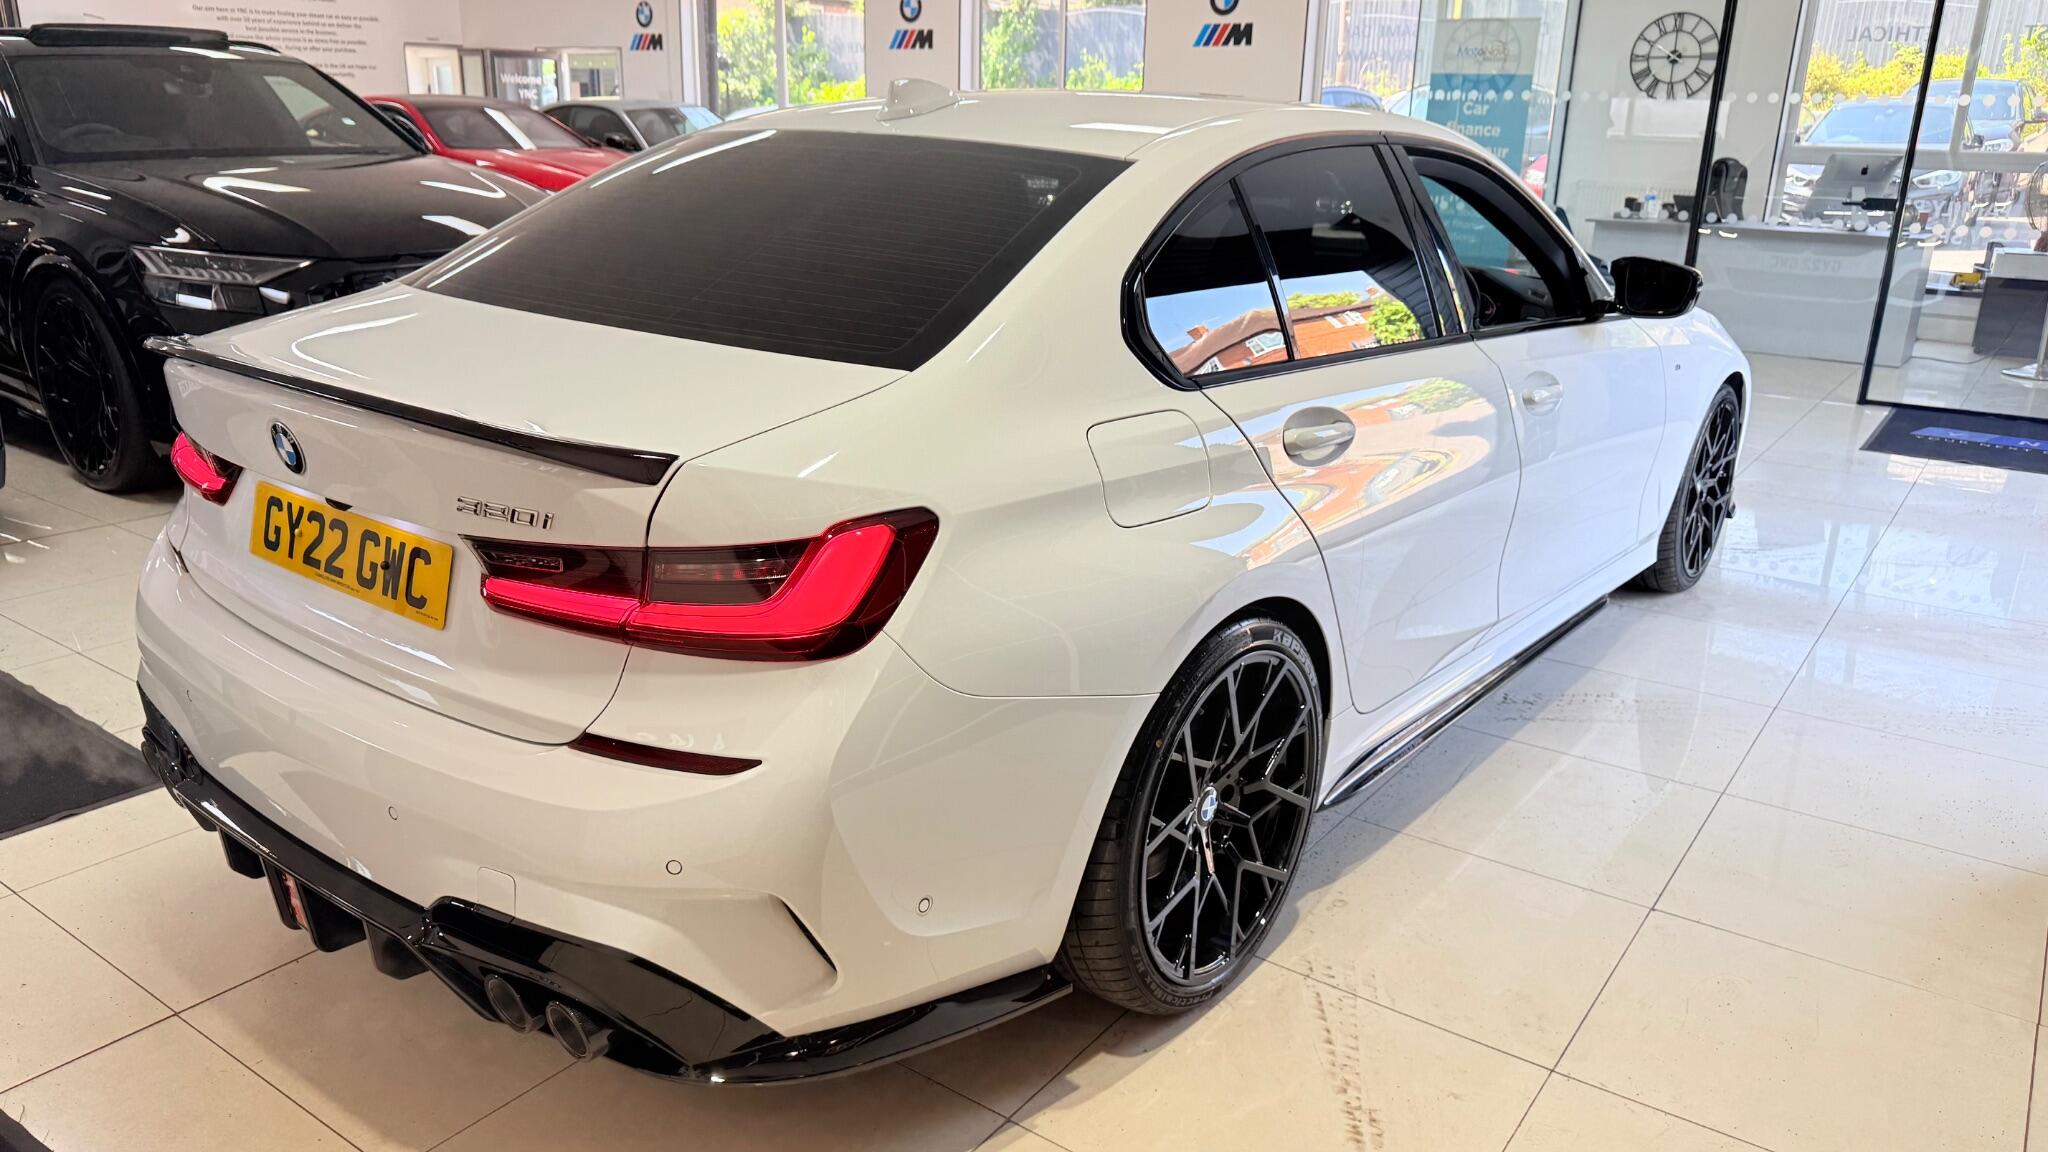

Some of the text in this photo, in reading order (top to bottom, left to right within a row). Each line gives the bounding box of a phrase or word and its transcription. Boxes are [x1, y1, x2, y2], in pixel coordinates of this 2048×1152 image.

[1463, 101, 1490, 116] Car
[456, 496, 555, 530] 320i
[264, 496, 432, 610] GY22 GWC
